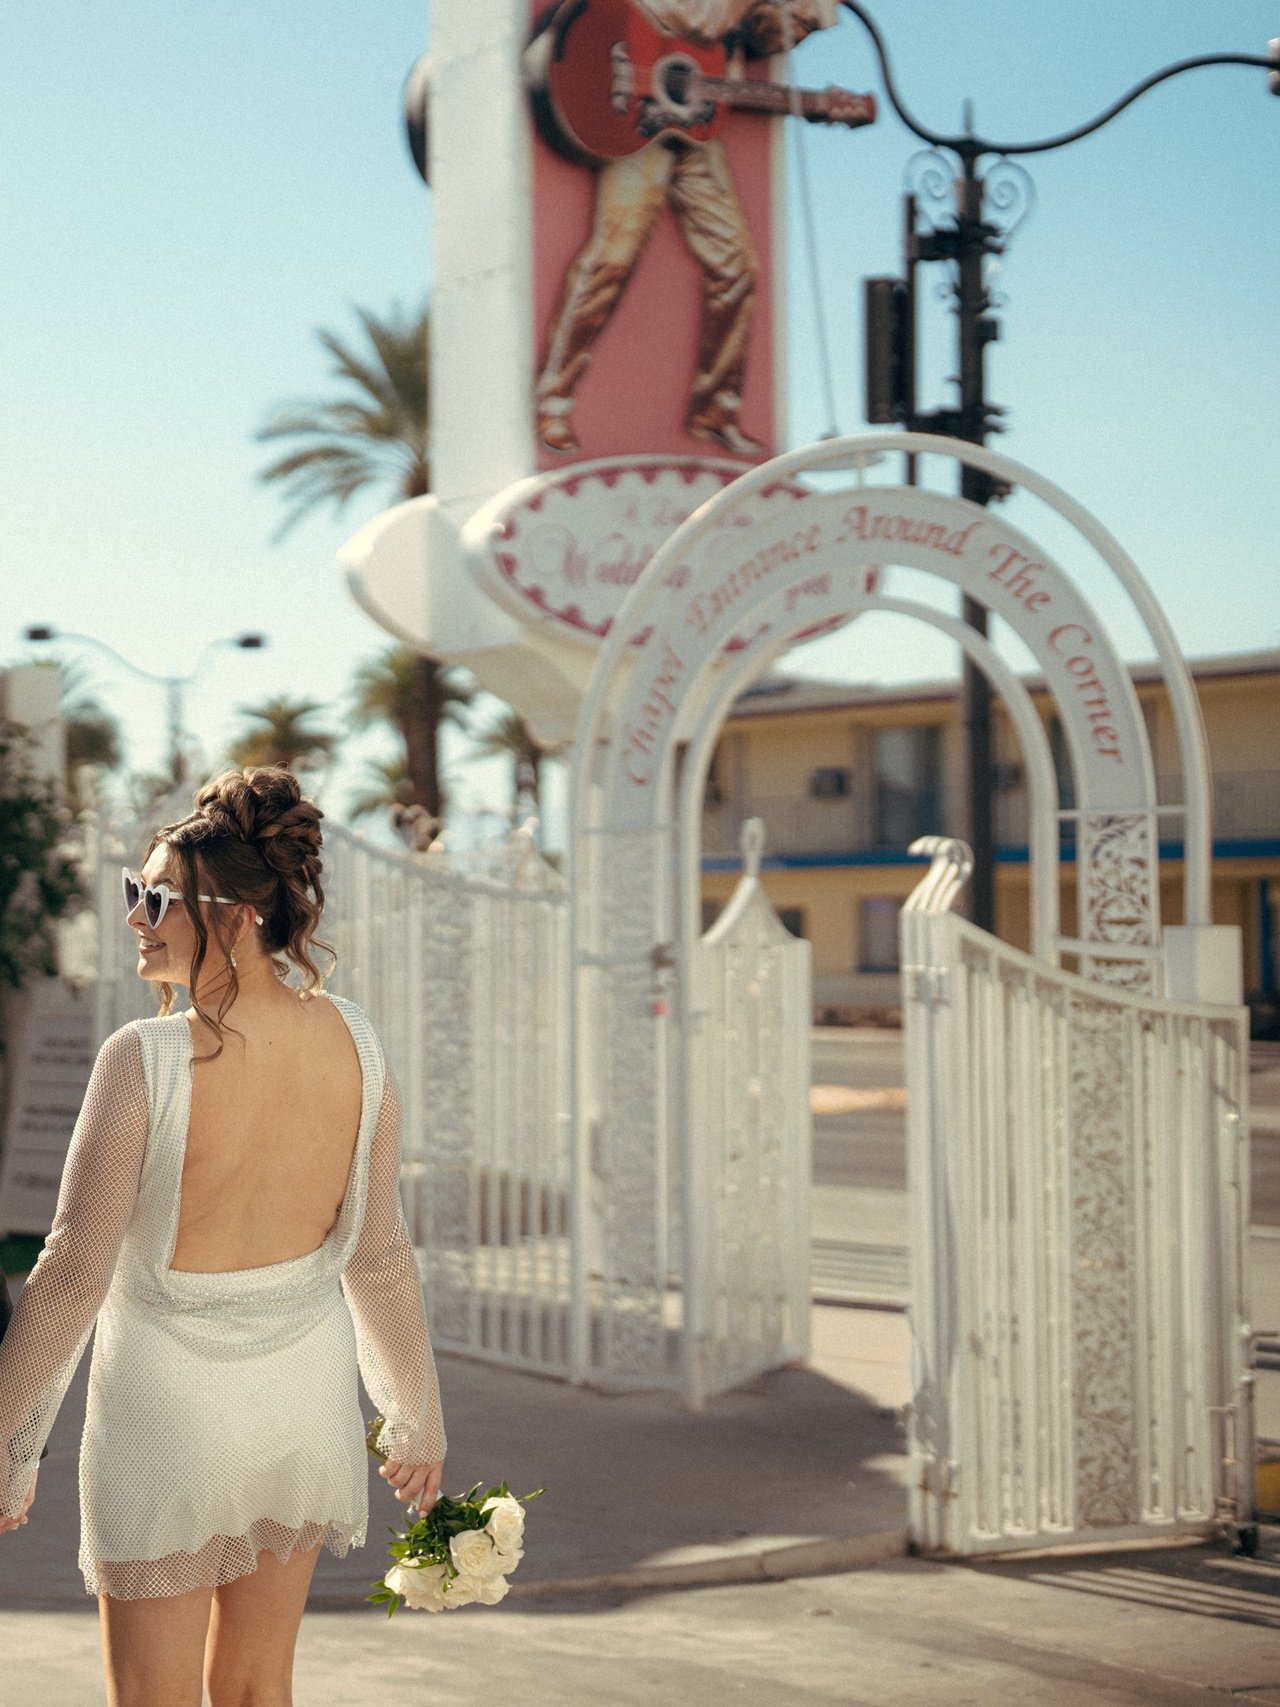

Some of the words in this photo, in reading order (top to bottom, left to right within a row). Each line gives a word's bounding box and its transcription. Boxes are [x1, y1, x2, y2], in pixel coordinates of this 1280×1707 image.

[684, 524, 821, 637] Entrance
[835, 504, 985, 557] Around
[987, 542, 1052, 613] The
[1047, 623, 1123, 765] Corner
